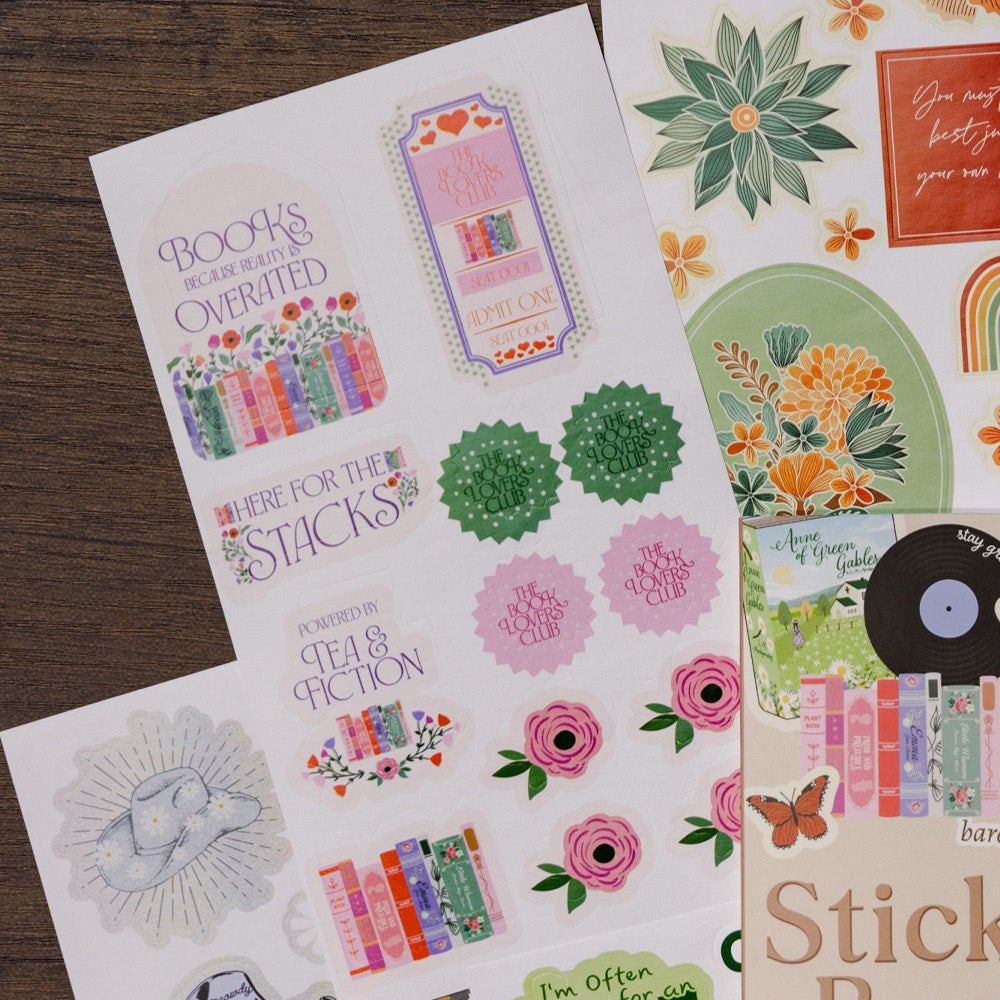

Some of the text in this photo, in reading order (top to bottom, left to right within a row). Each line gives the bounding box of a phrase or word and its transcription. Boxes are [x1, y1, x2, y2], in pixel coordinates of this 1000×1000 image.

[912, 80, 954, 120] You
[928, 117, 989, 148] best
[915, 169, 955, 196] your
[963, 166, 989, 178] own
[158, 202, 313, 273] BOOKS
[184, 244, 301, 291] BECAUSE REALITY IS
[175, 258, 328, 333] OVERATED
[467, 285, 558, 330] ADMIT ONE
[234, 452, 387, 522] HERE FOR THE
[246, 483, 400, 581] STACKS
[770, 527, 821, 553] Anne
[956, 528, 985, 552] stay
[633, 548, 694, 577] BOOK
[638, 541, 663, 560] THE
[795, 541, 856, 566] of Green
[836, 547, 879, 578] Gables
[625, 565, 690, 595] LOVERS
[646, 582, 687, 606] CLUB
[297, 600, 380, 637] POWERED BY
[301, 624, 389, 674] TEA &
[293, 648, 424, 710] FICTION
[910, 725, 924, 762] Emma
[585, 965, 653, 992] Often
[663, 981, 695, 1000] an
